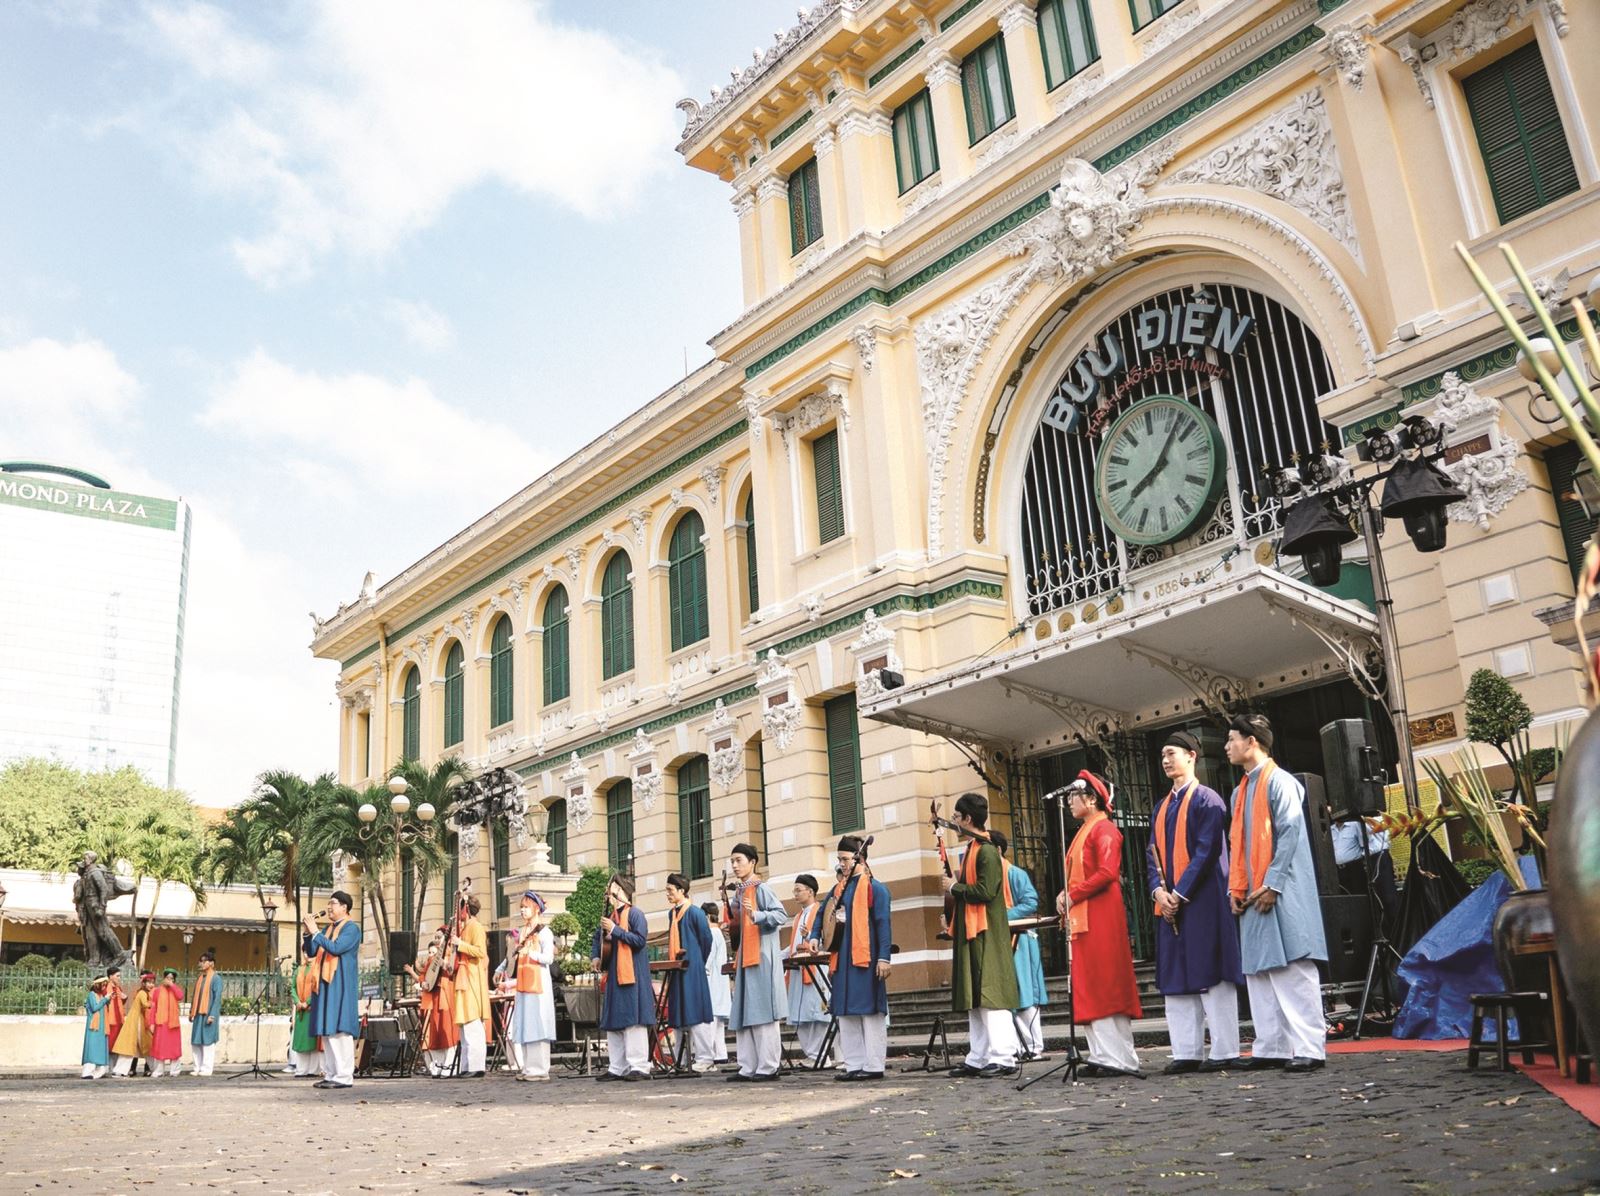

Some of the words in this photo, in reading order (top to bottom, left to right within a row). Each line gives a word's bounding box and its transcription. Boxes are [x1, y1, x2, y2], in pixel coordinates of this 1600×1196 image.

[1041, 333, 1123, 433] BƯU
[1137, 288, 1254, 358] ĐIỆN
[1190, 360, 1224, 379] MINH
[77, 493, 148, 519] PLAZA
[1154, 579, 1179, 598] 1886
